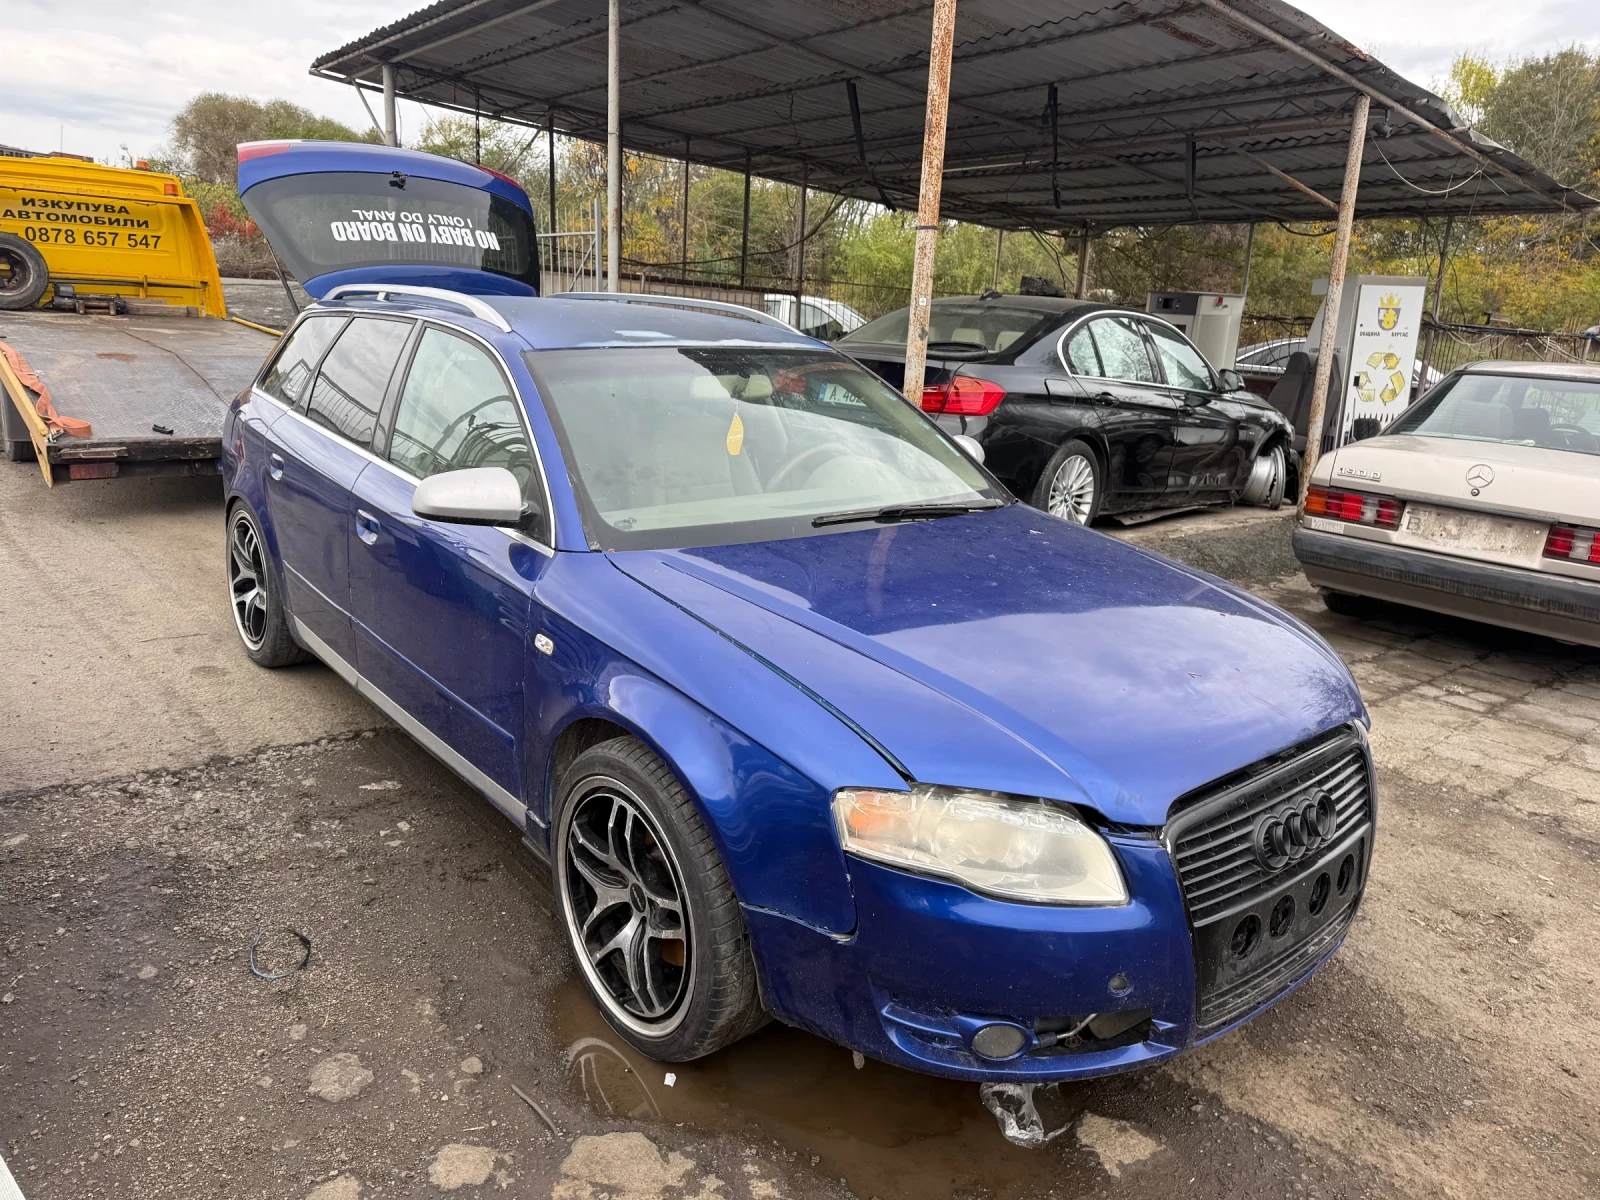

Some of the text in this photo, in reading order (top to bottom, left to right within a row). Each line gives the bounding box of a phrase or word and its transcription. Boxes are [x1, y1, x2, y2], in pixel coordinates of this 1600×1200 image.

[21, 197, 130, 215] ИЗКУПУВА
[2, 209, 149, 229] АВТОМОБИЛИ
[352, 209, 473, 228] I ONLY DO ANAL
[25, 226, 161, 249] 0878 657 547
[331, 221, 501, 251] NO BABY ON BOARD
[1339, 467, 1367, 477] 190
